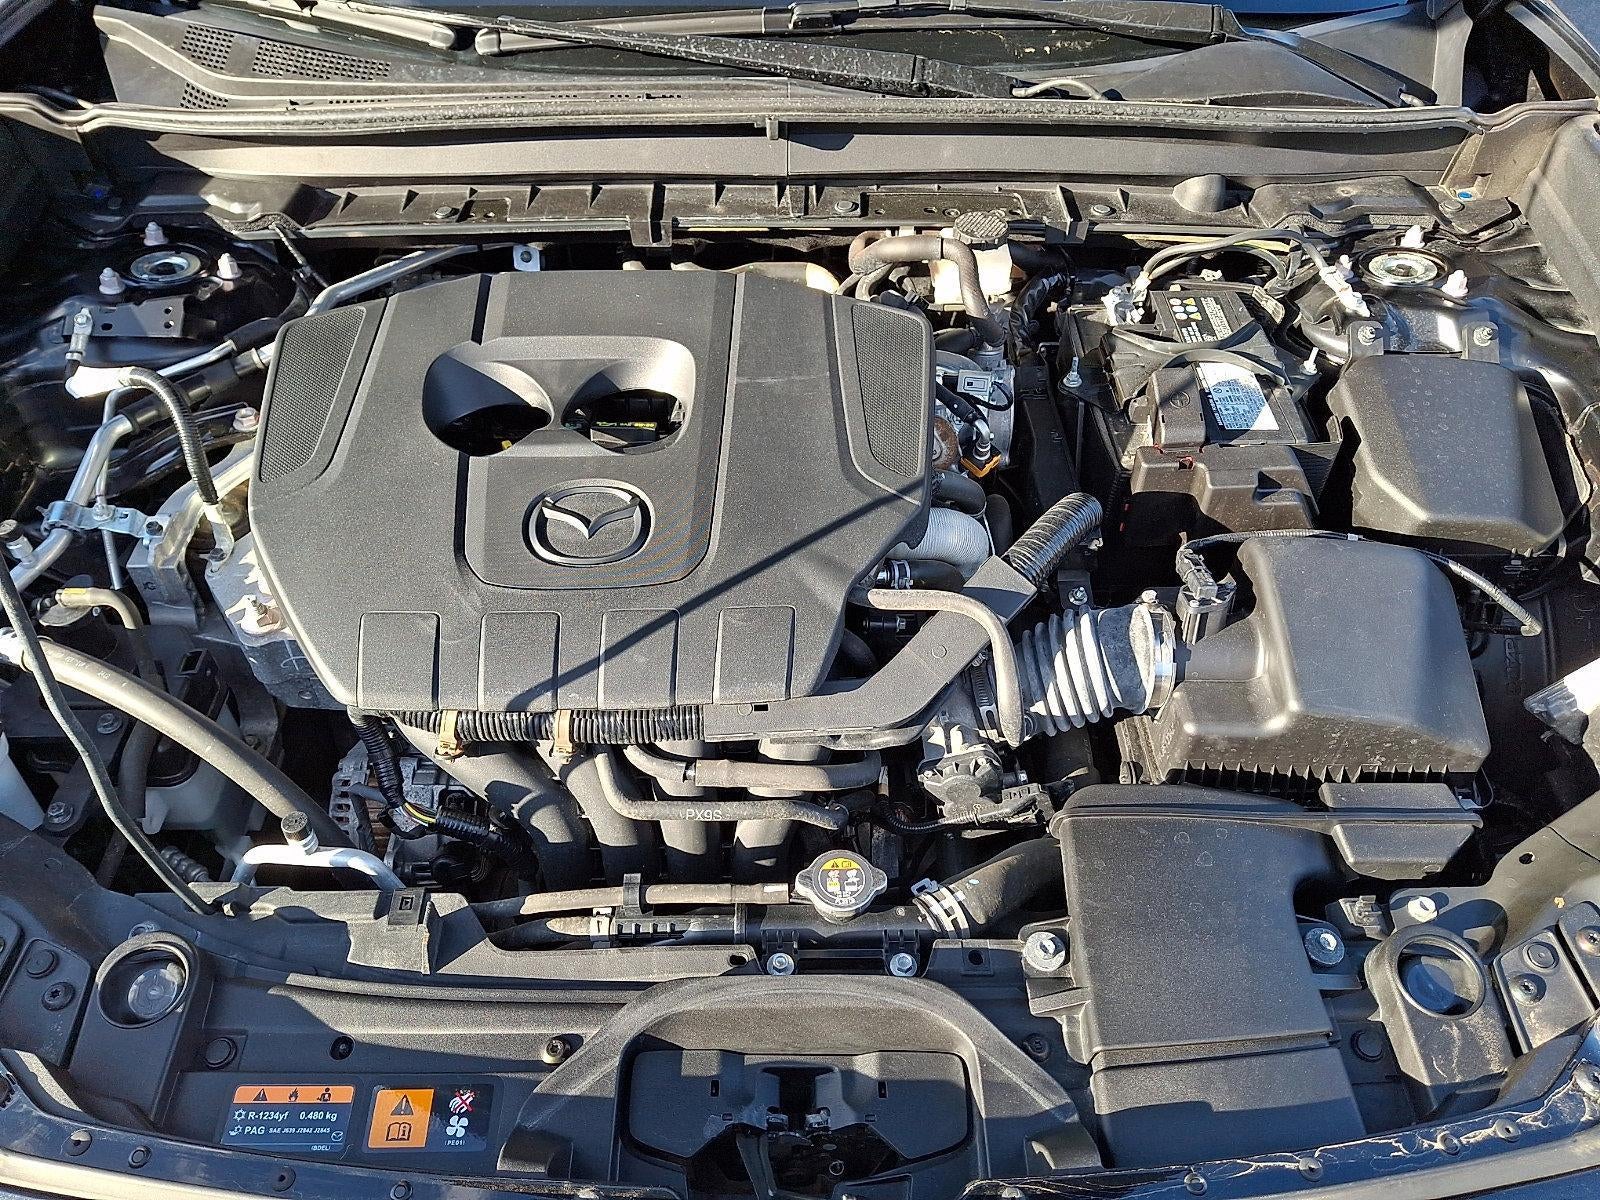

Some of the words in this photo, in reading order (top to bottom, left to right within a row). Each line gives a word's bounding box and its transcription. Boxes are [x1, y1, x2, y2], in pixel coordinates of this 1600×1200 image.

[685, 808, 723, 821] PX9S
[247, 1111, 290, 1122] R-1234yf
[299, 1111, 324, 1120] 0.480
[325, 1111, 338, 1122] kg
[244, 1126, 266, 1135] PAG
